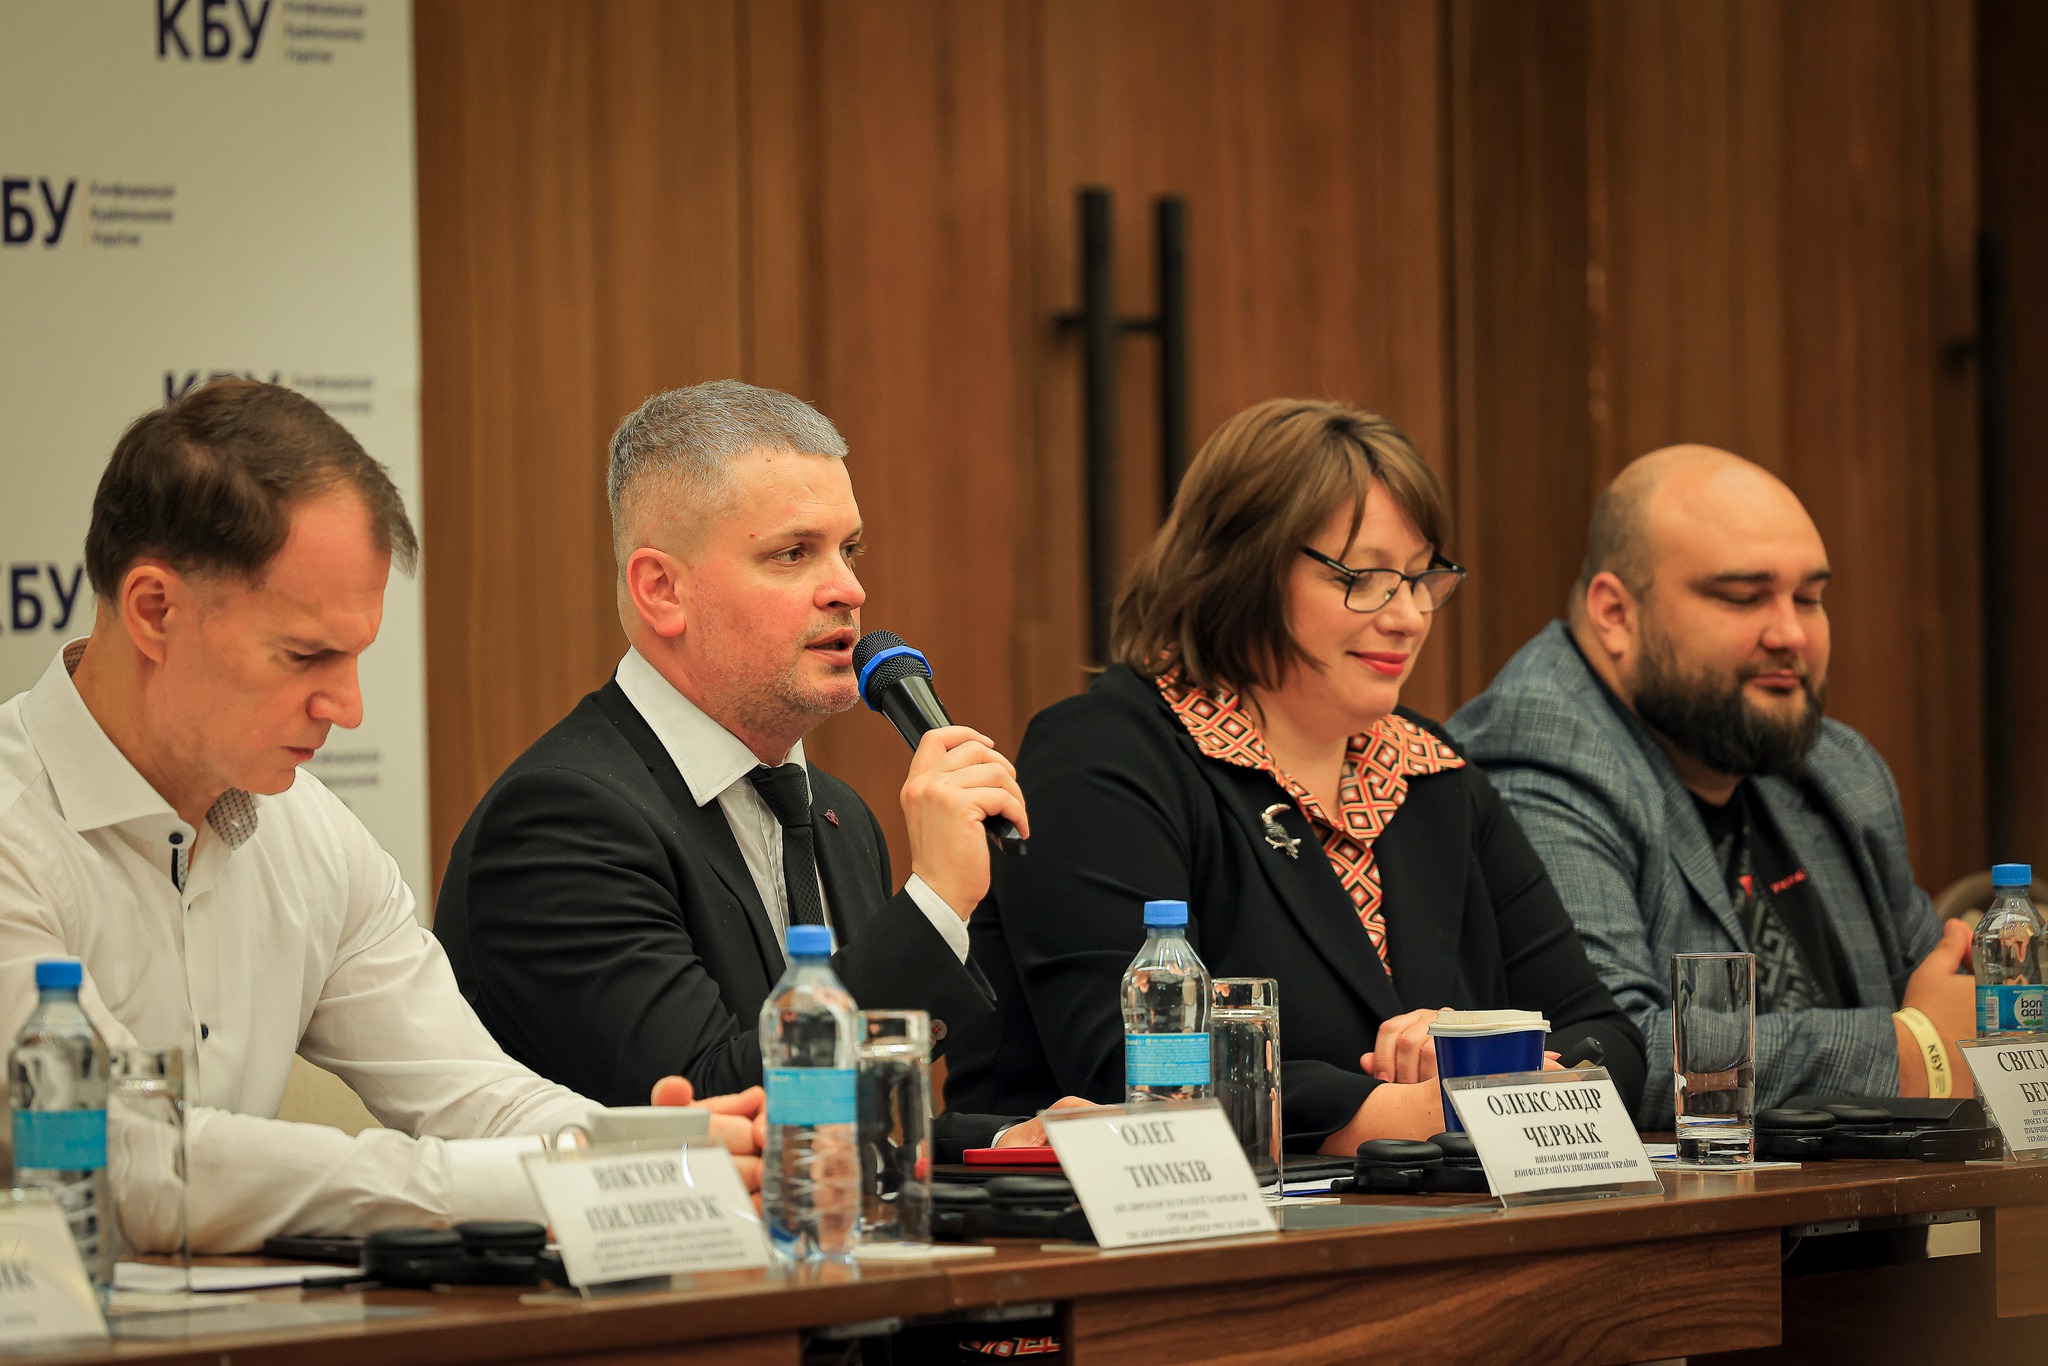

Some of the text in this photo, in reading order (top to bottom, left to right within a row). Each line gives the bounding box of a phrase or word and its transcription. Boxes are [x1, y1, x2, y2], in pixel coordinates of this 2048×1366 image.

[156, 0, 270, 60] КБУ
[0, 565, 83, 631] БУ
[2020, 998, 2042, 1008] bon
[1927, 1043, 1944, 1072] КБУ
[1486, 1087, 1603, 1116] ОЛЕКСАНДР
[1120, 1120, 1175, 1147] ОЛЕГ
[1522, 1122, 1603, 1148] ЧЕРВАК
[1535, 1150, 1609, 1164] ВИКОНАВЧИЙ ДИРЕКТОР
[1124, 1160, 1213, 1189] ТИМКІВ
